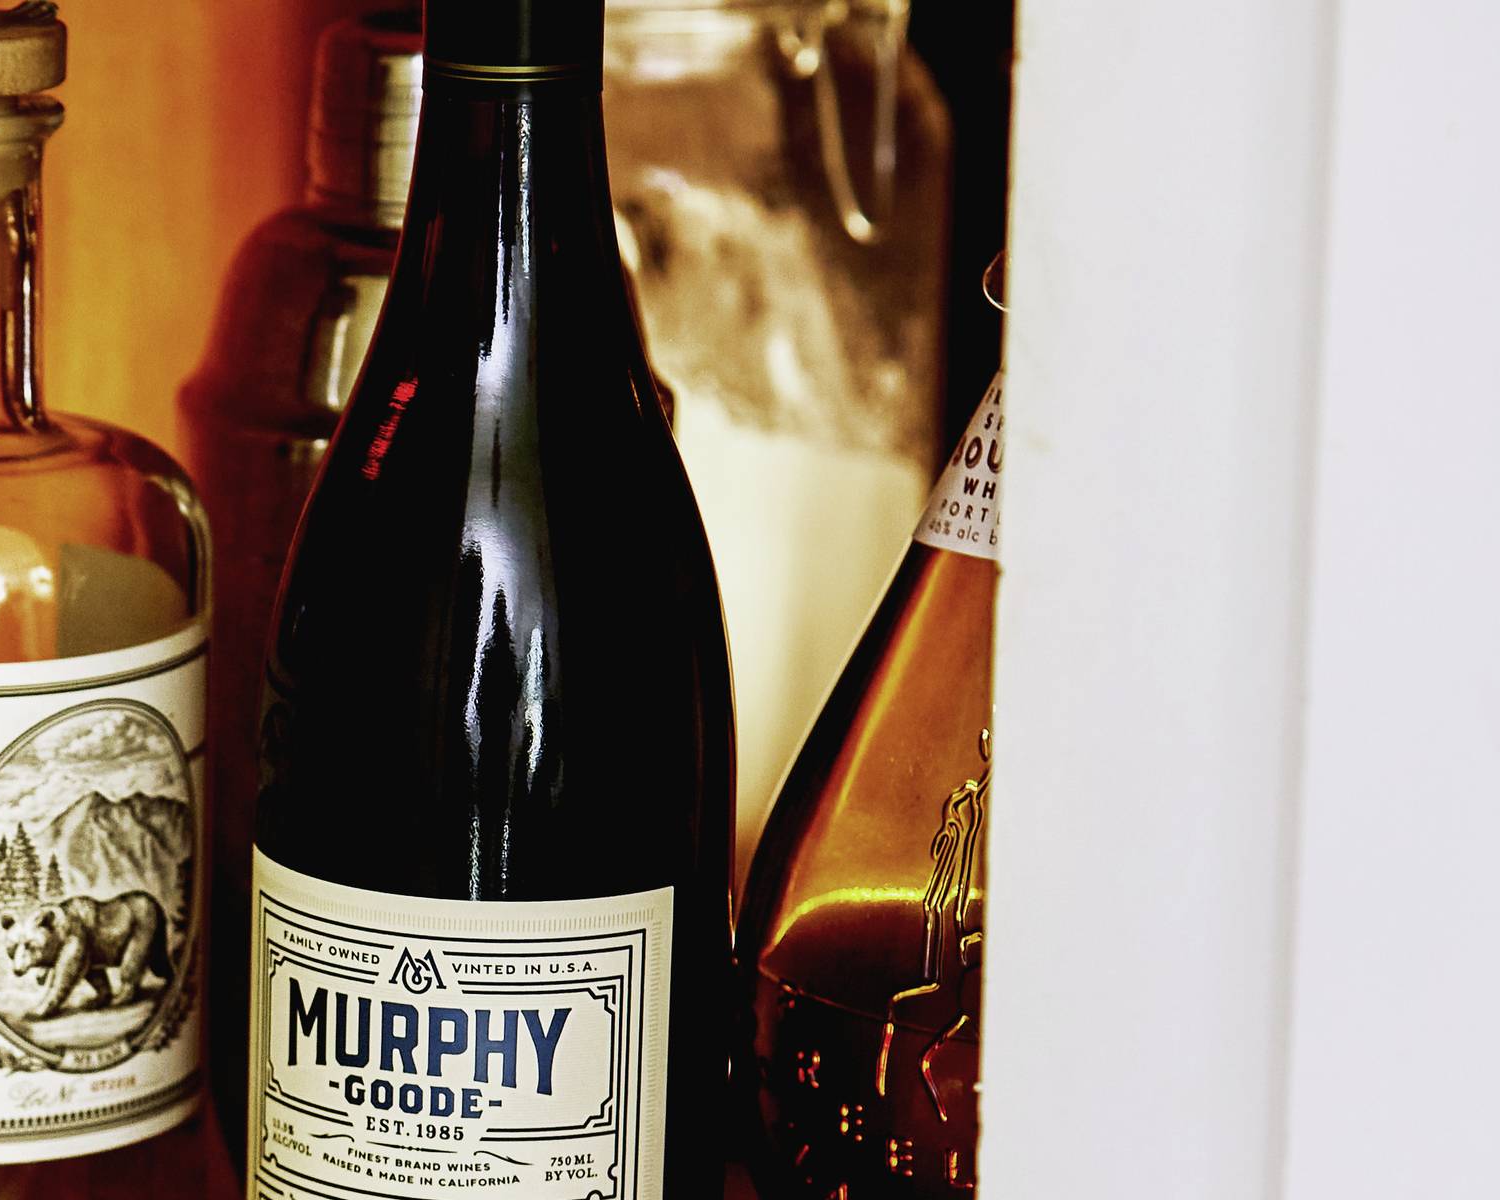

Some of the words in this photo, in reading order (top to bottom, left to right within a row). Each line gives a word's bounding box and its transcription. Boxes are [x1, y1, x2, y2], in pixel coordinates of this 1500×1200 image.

[963, 477, 996, 500] WH
[957, 525, 980, 543] alc
[283, 930, 323, 953] FAMILY
[328, 945, 381, 965] OWNED
[451, 962, 516, 975] VINTED
[524, 963, 541, 975] IN
[549, 961, 598, 974] U.S.A.
[287, 976, 574, 1096] MURPHY
[322, 1152, 362, 1174] RAISED
[366, 1167, 374, 1178] &
[378, 1169, 415, 1185] MADE
[419, 1176, 433, 1186] IN
[437, 1174, 521, 1188] CALIFORNIA
[347, 1147, 392, 1167] FINEST
[395, 1158, 441, 1172] BRAND
[446, 1161, 491, 1173] WINES
[545, 1170, 564, 1182] BY
[566, 1167, 598, 1181] VOL.
